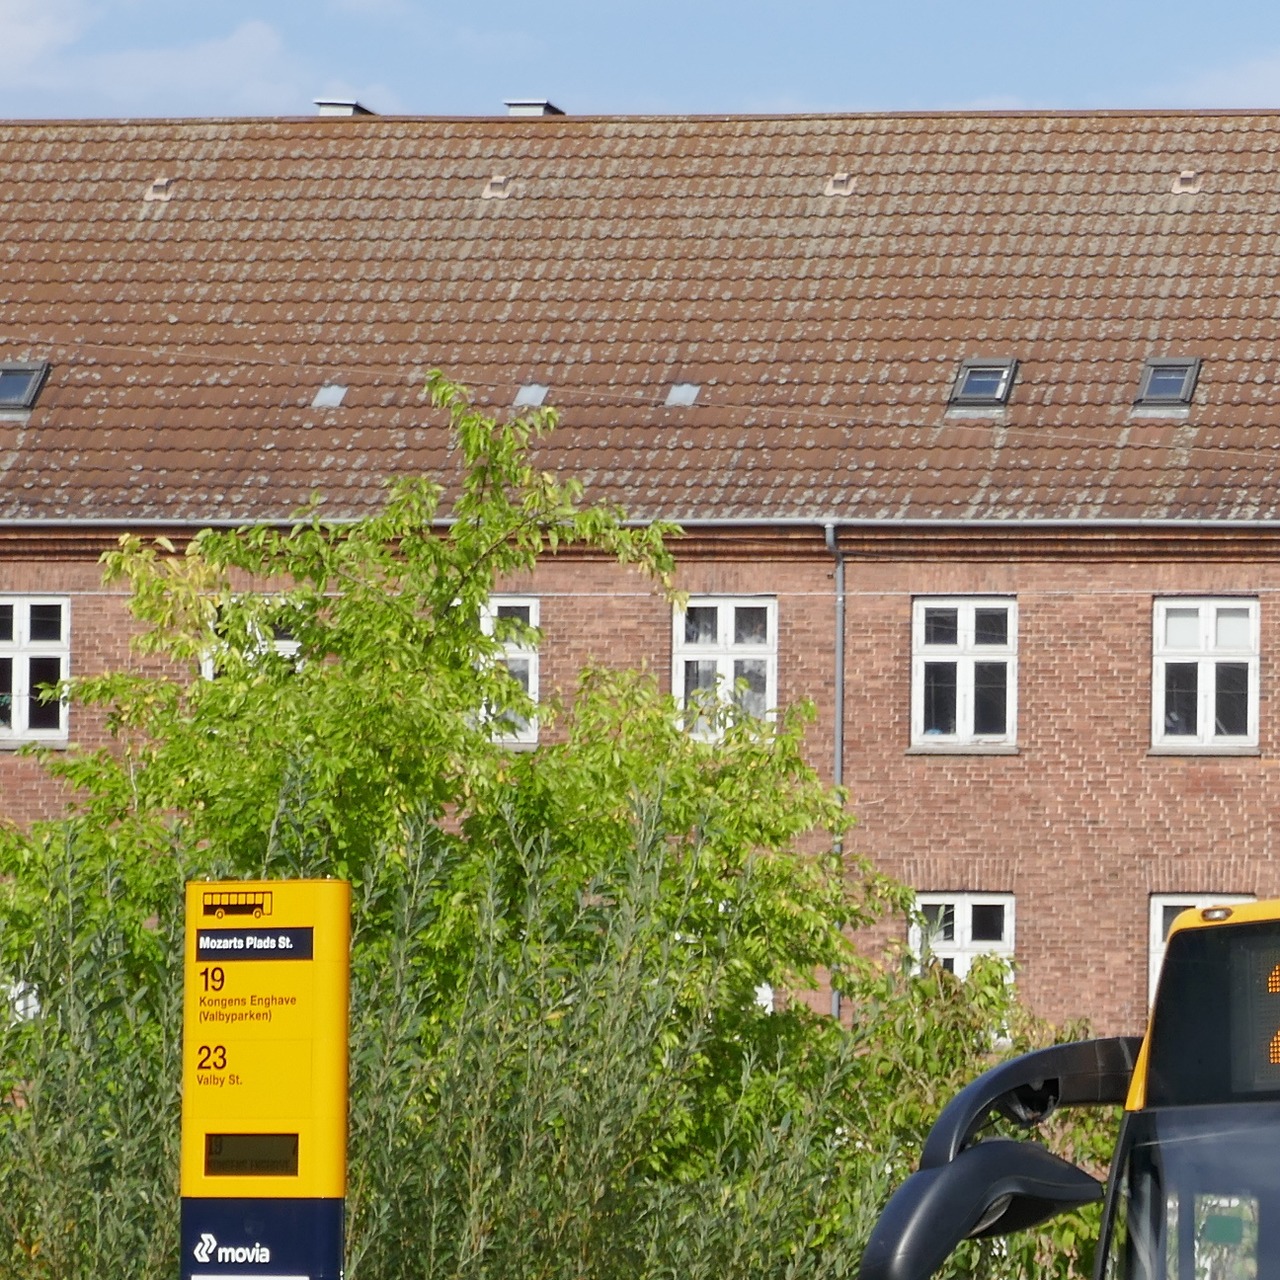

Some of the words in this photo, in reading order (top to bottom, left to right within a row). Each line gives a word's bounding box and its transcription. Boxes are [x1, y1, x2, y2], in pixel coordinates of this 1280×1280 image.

[199, 936, 244, 949] Mozarts
[245, 935, 276, 949] Plads
[277, 936, 293, 949] St.
[199, 966, 225, 992] 19
[199, 996, 247, 1009] Kongens
[250, 995, 297, 1008] Enghave
[198, 1010, 272, 1024] (Valbyparken)
[197, 1045, 227, 1071] 23
[196, 1073, 225, 1088] Valby
[228, 1073, 243, 1086] St.
[217, 1242, 271, 1263] movia
